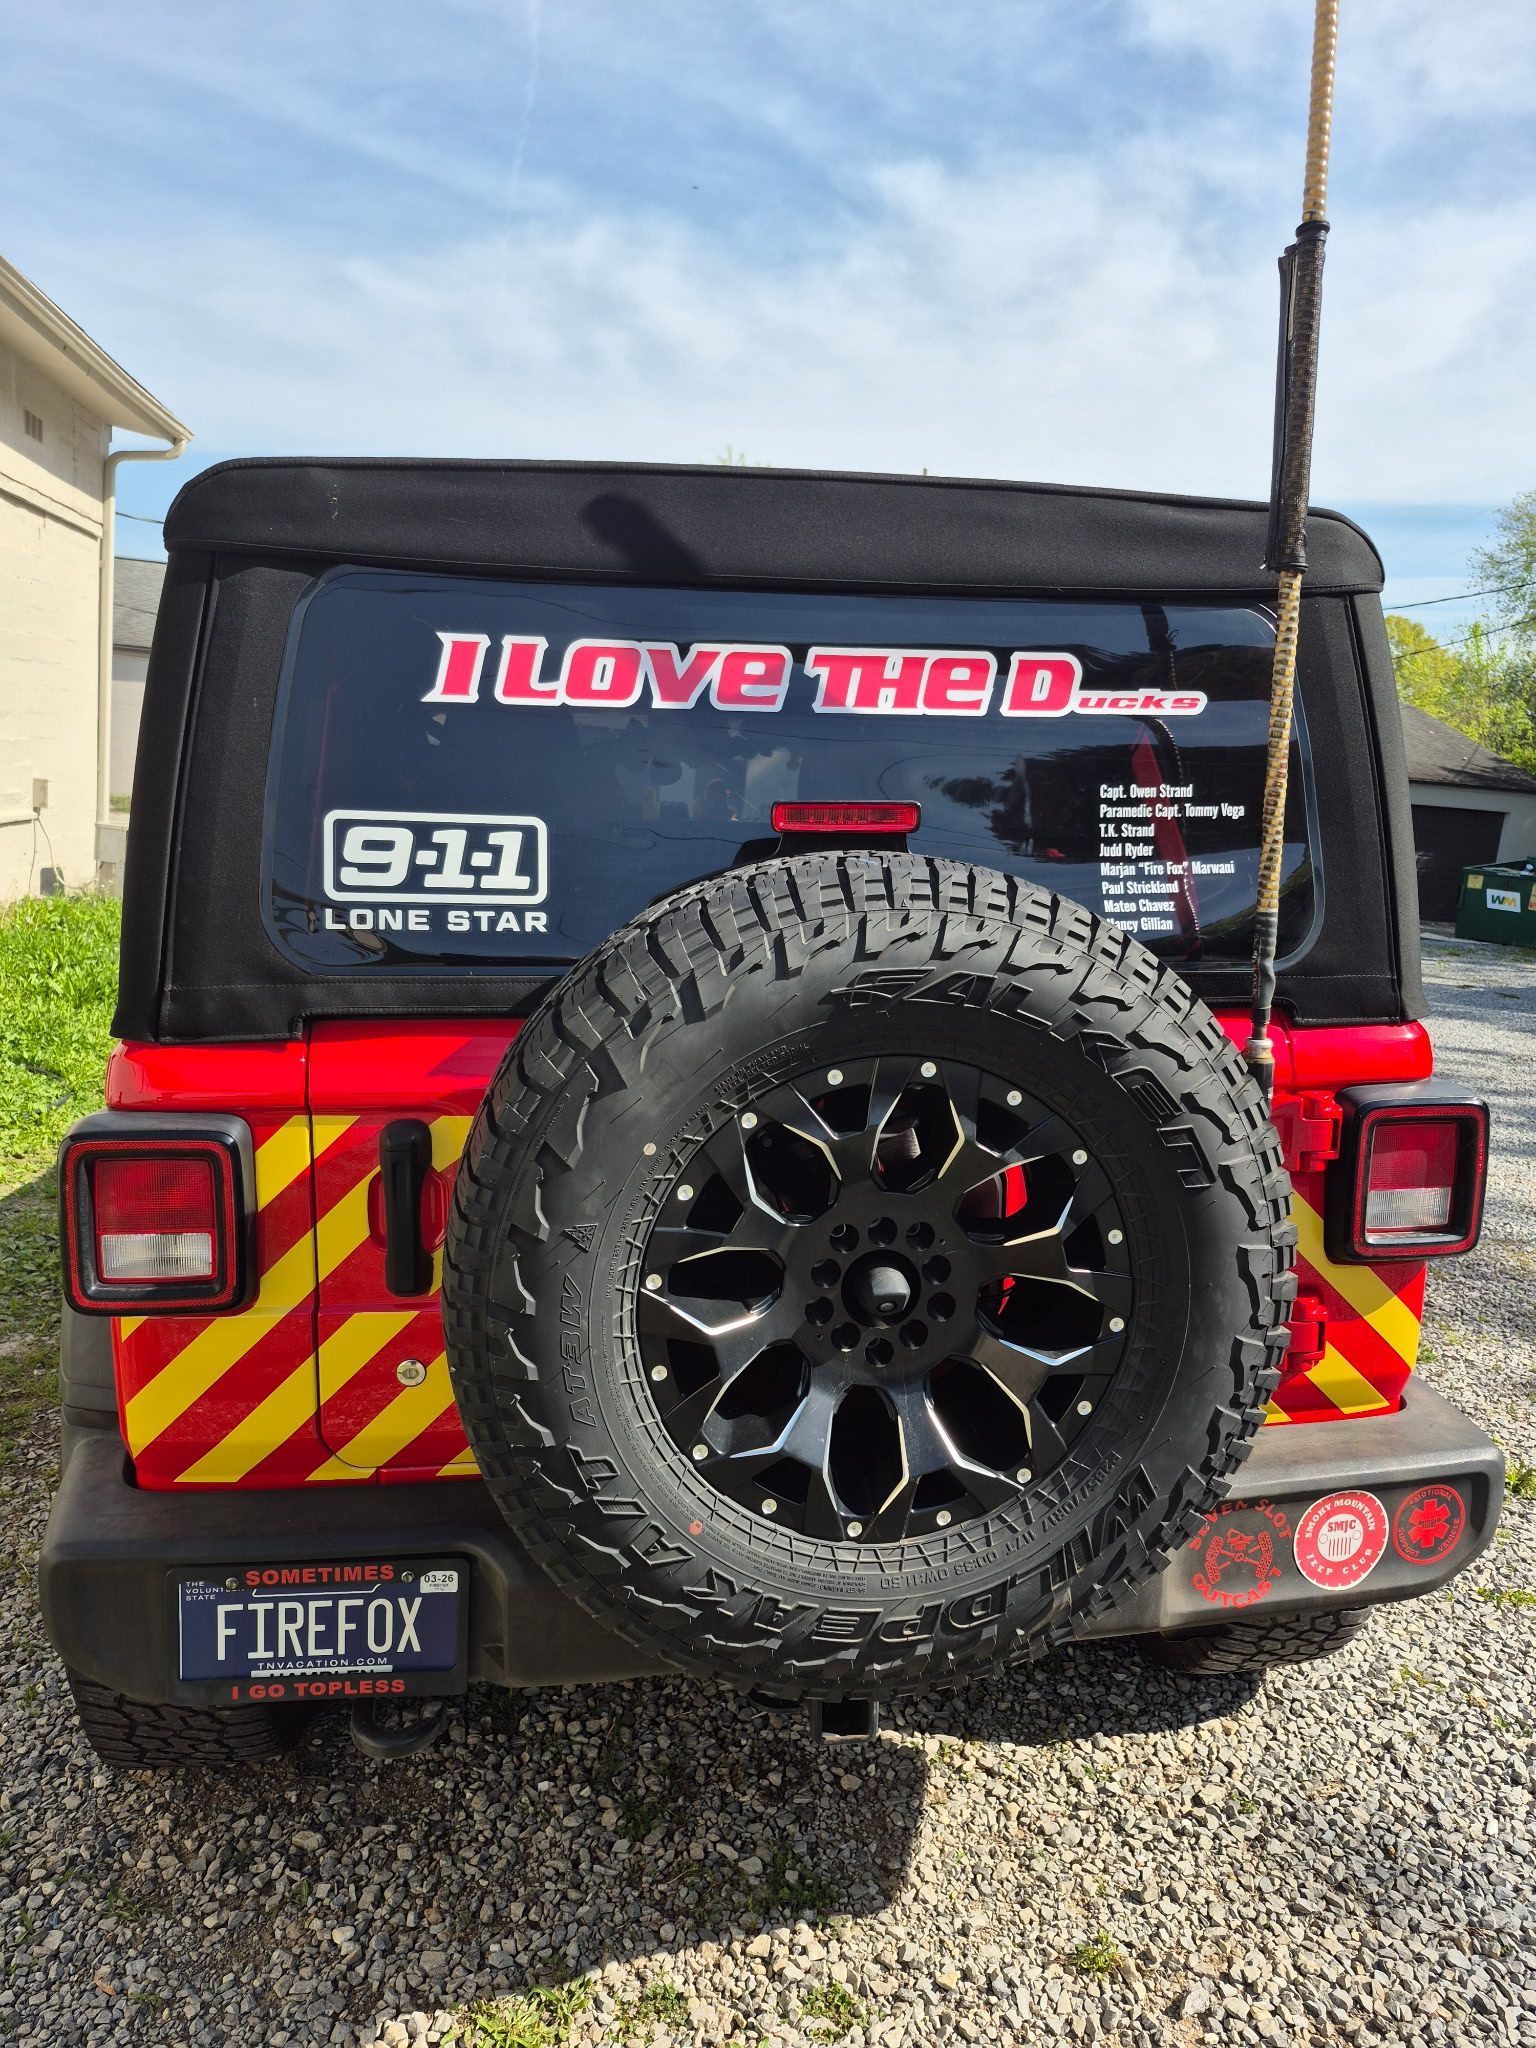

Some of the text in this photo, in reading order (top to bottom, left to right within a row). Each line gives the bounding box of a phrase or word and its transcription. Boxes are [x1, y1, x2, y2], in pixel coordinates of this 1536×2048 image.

[421, 632, 491, 704] I
[1100, 783, 1193, 801] Capt. Owen Strand
[1100, 803, 1245, 820] Paramedic Capt. Tommy Vega
[1099, 823, 1155, 838] T.K. Strand
[1099, 843, 1154, 859] Judd Ryder
[1100, 862, 1136, 878] Marjan
[1191, 861, 1235, 875] Marwani
[1102, 880, 1179, 895] Paul Strickland
[1104, 899, 1176, 913] Mateo Chavez
[1491, 895, 1516, 907] WM
[325, 908, 549, 933] LONE STAR
[1140, 917, 1173, 931] Gillian
[818, 966, 1217, 1188] FALKEN
[560, 1273, 598, 1427] AT3W
[1254, 1499, 1292, 1538] SLOT
[1305, 1499, 1376, 1539] SMOKY MOUNTAIN
[1327, 1520, 1357, 1533] SMJC
[1306, 1548, 1373, 1575] JEEP CLUB
[245, 1564, 395, 1586] SOMETIMES
[424, 1574, 454, 1583] 03-26
[217, 1597, 422, 1661] FIREFOX
[258, 1657, 388, 1670] TNVACATION.COM
[231, 1679, 406, 1700] I GO TOPLESS
